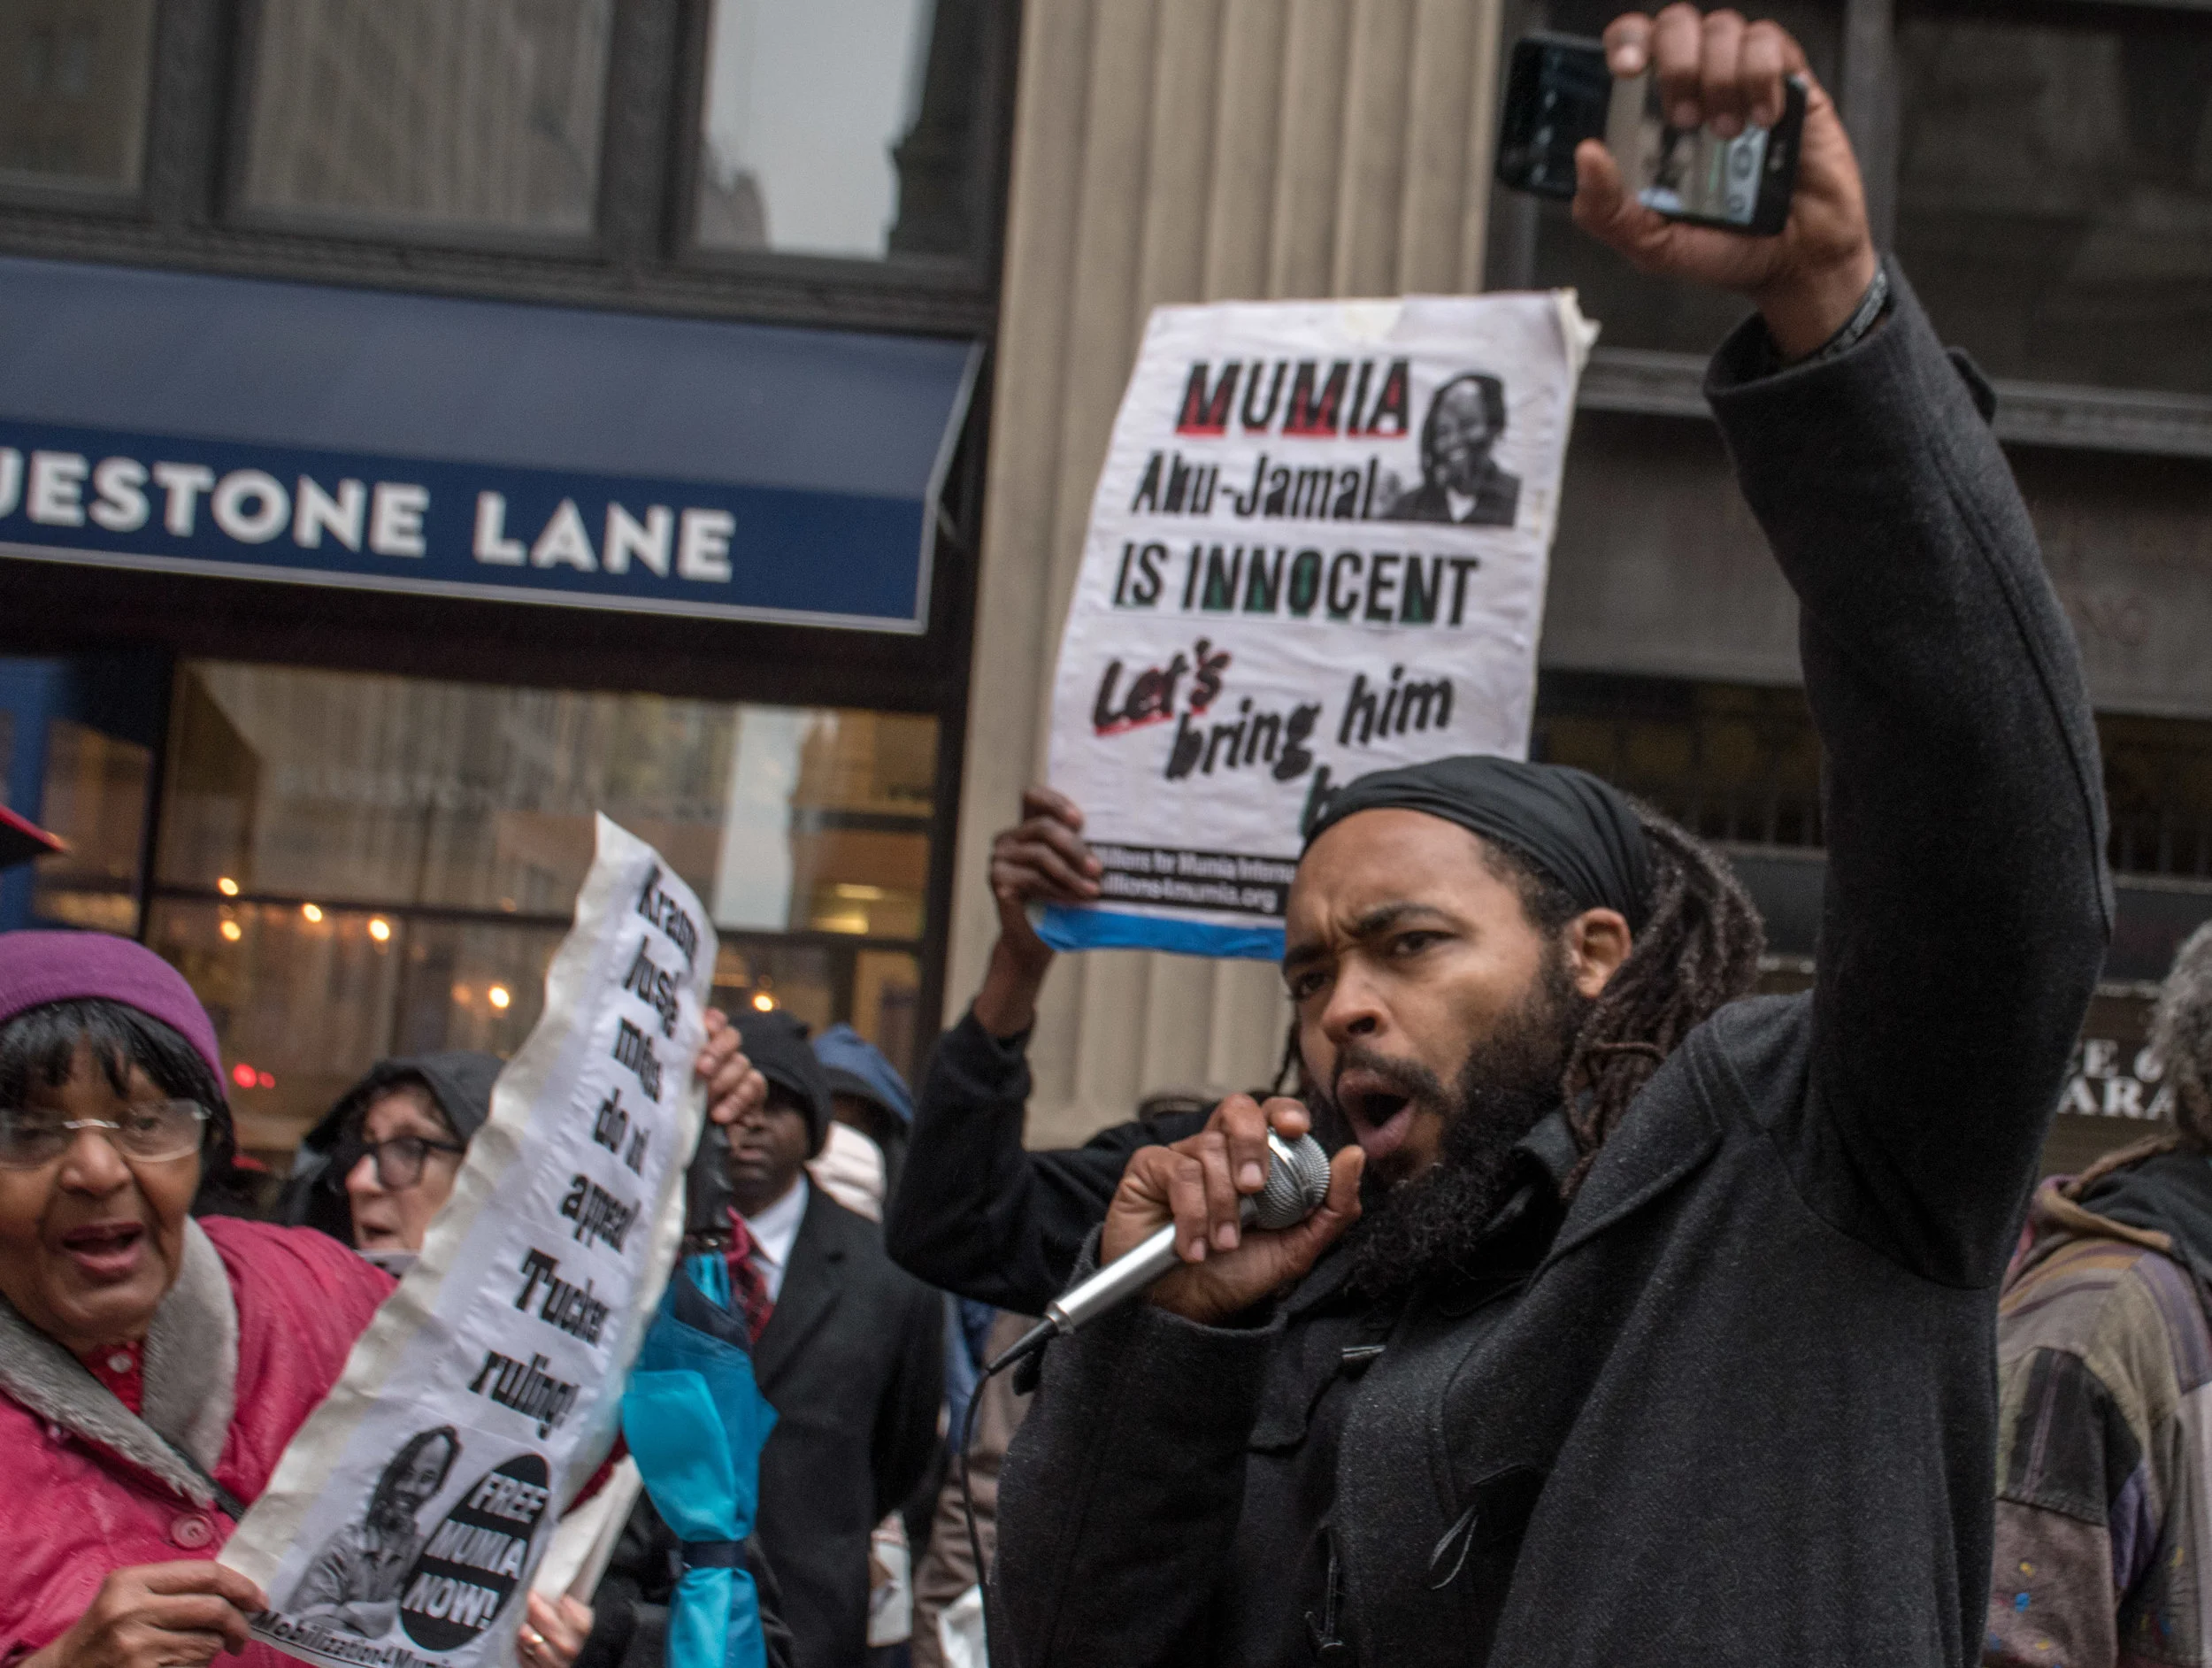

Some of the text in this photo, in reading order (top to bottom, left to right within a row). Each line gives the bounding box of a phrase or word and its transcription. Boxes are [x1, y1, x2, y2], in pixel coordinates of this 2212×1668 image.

[1175, 357, 1410, 437] MUMIA
[1132, 450, 1379, 520] Abu-Jamal
[472, 491, 736, 582] LANE
[1114, 542, 1481, 626] IS INNOCENT
[1093, 635, 1232, 736] Let's
[1163, 664, 1454, 782] bring him
[2056, 1075, 2177, 1120] ARA
[469, 1471, 551, 1524] FREE
[425, 1519, 529, 1580] MUMIA
[401, 1572, 501, 1630] NOW!
